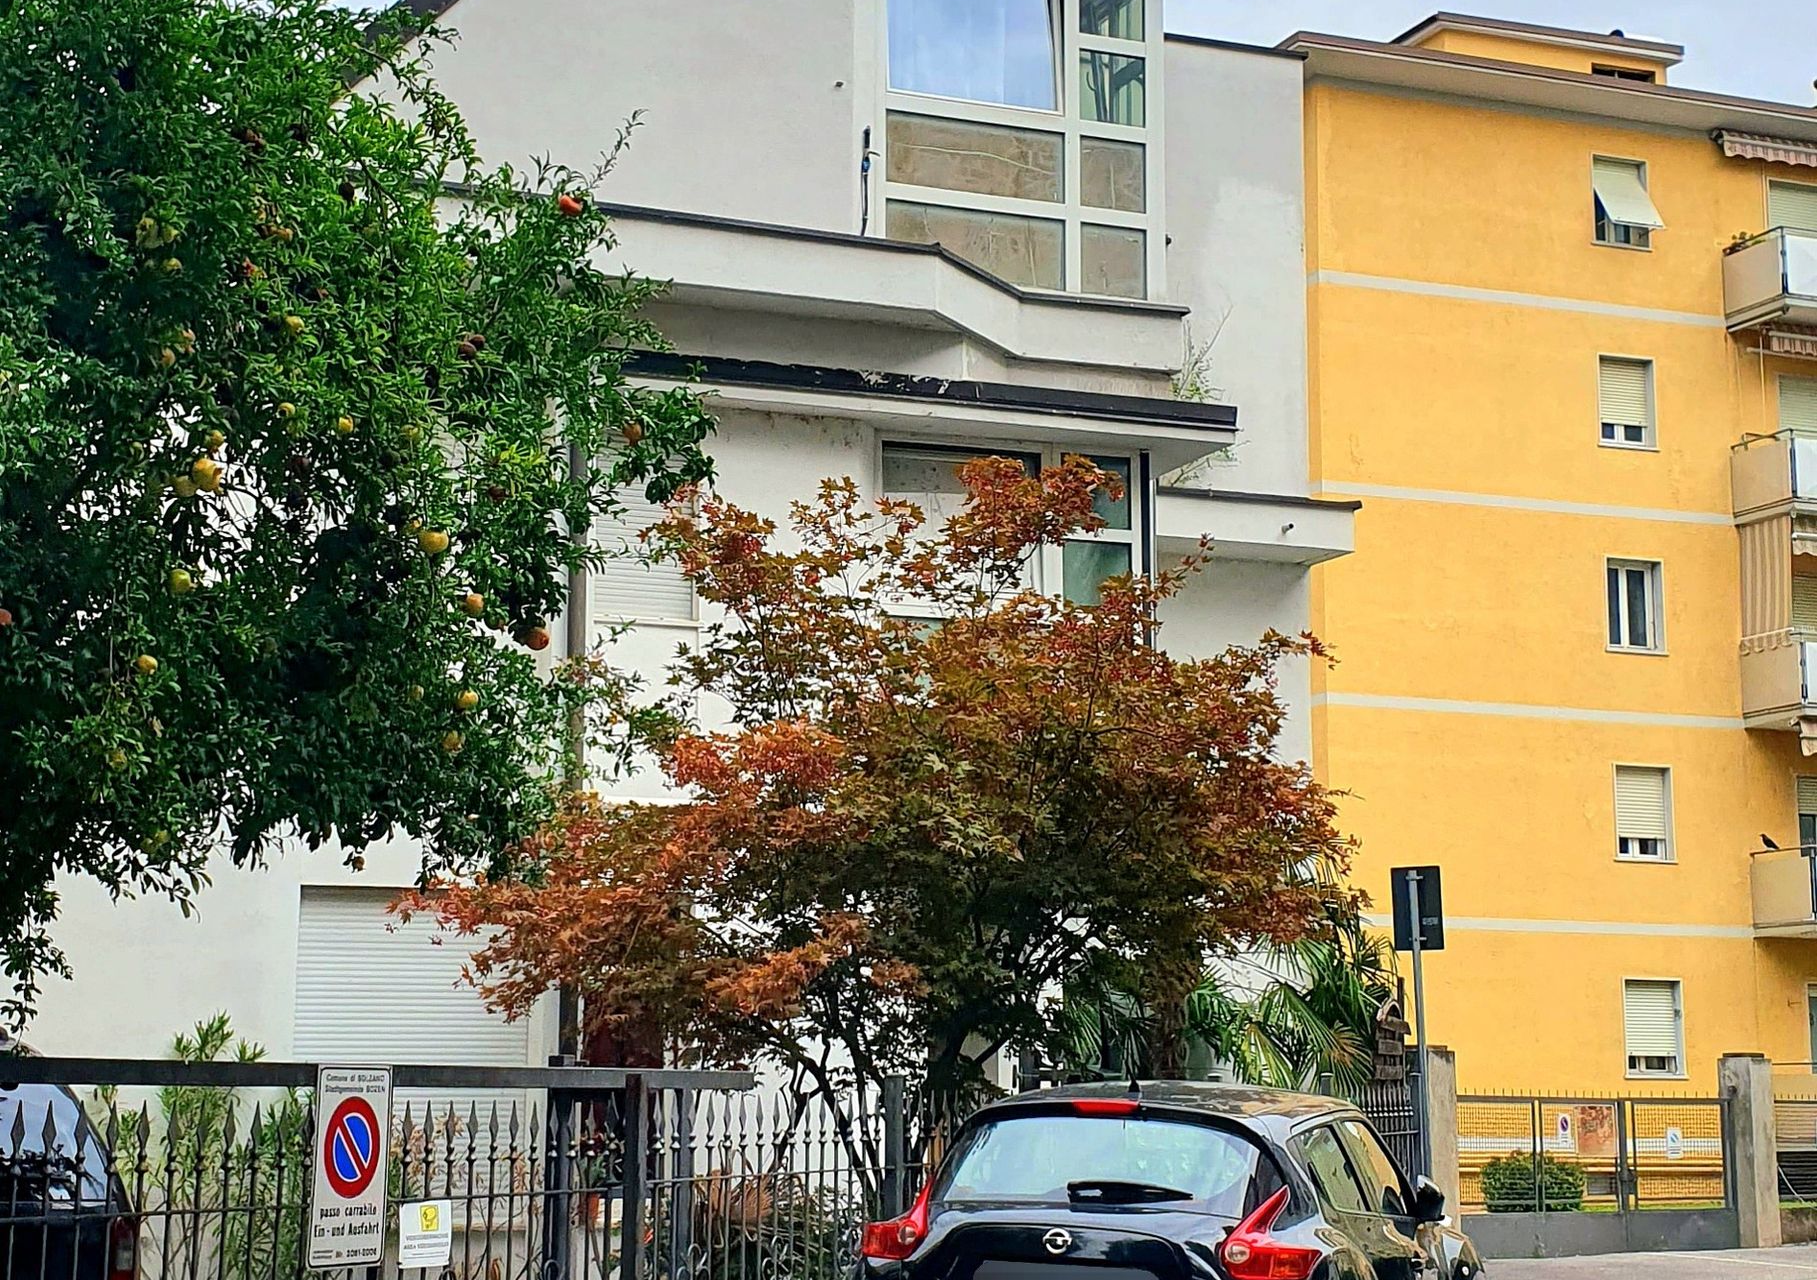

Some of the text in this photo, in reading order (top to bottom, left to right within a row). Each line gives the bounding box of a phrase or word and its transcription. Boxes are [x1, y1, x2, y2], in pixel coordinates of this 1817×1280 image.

[319, 1202, 377, 1220] passo carrabile
[331, 1223, 345, 1237] und
[348, 1221, 380, 1236] Ausfahrt
